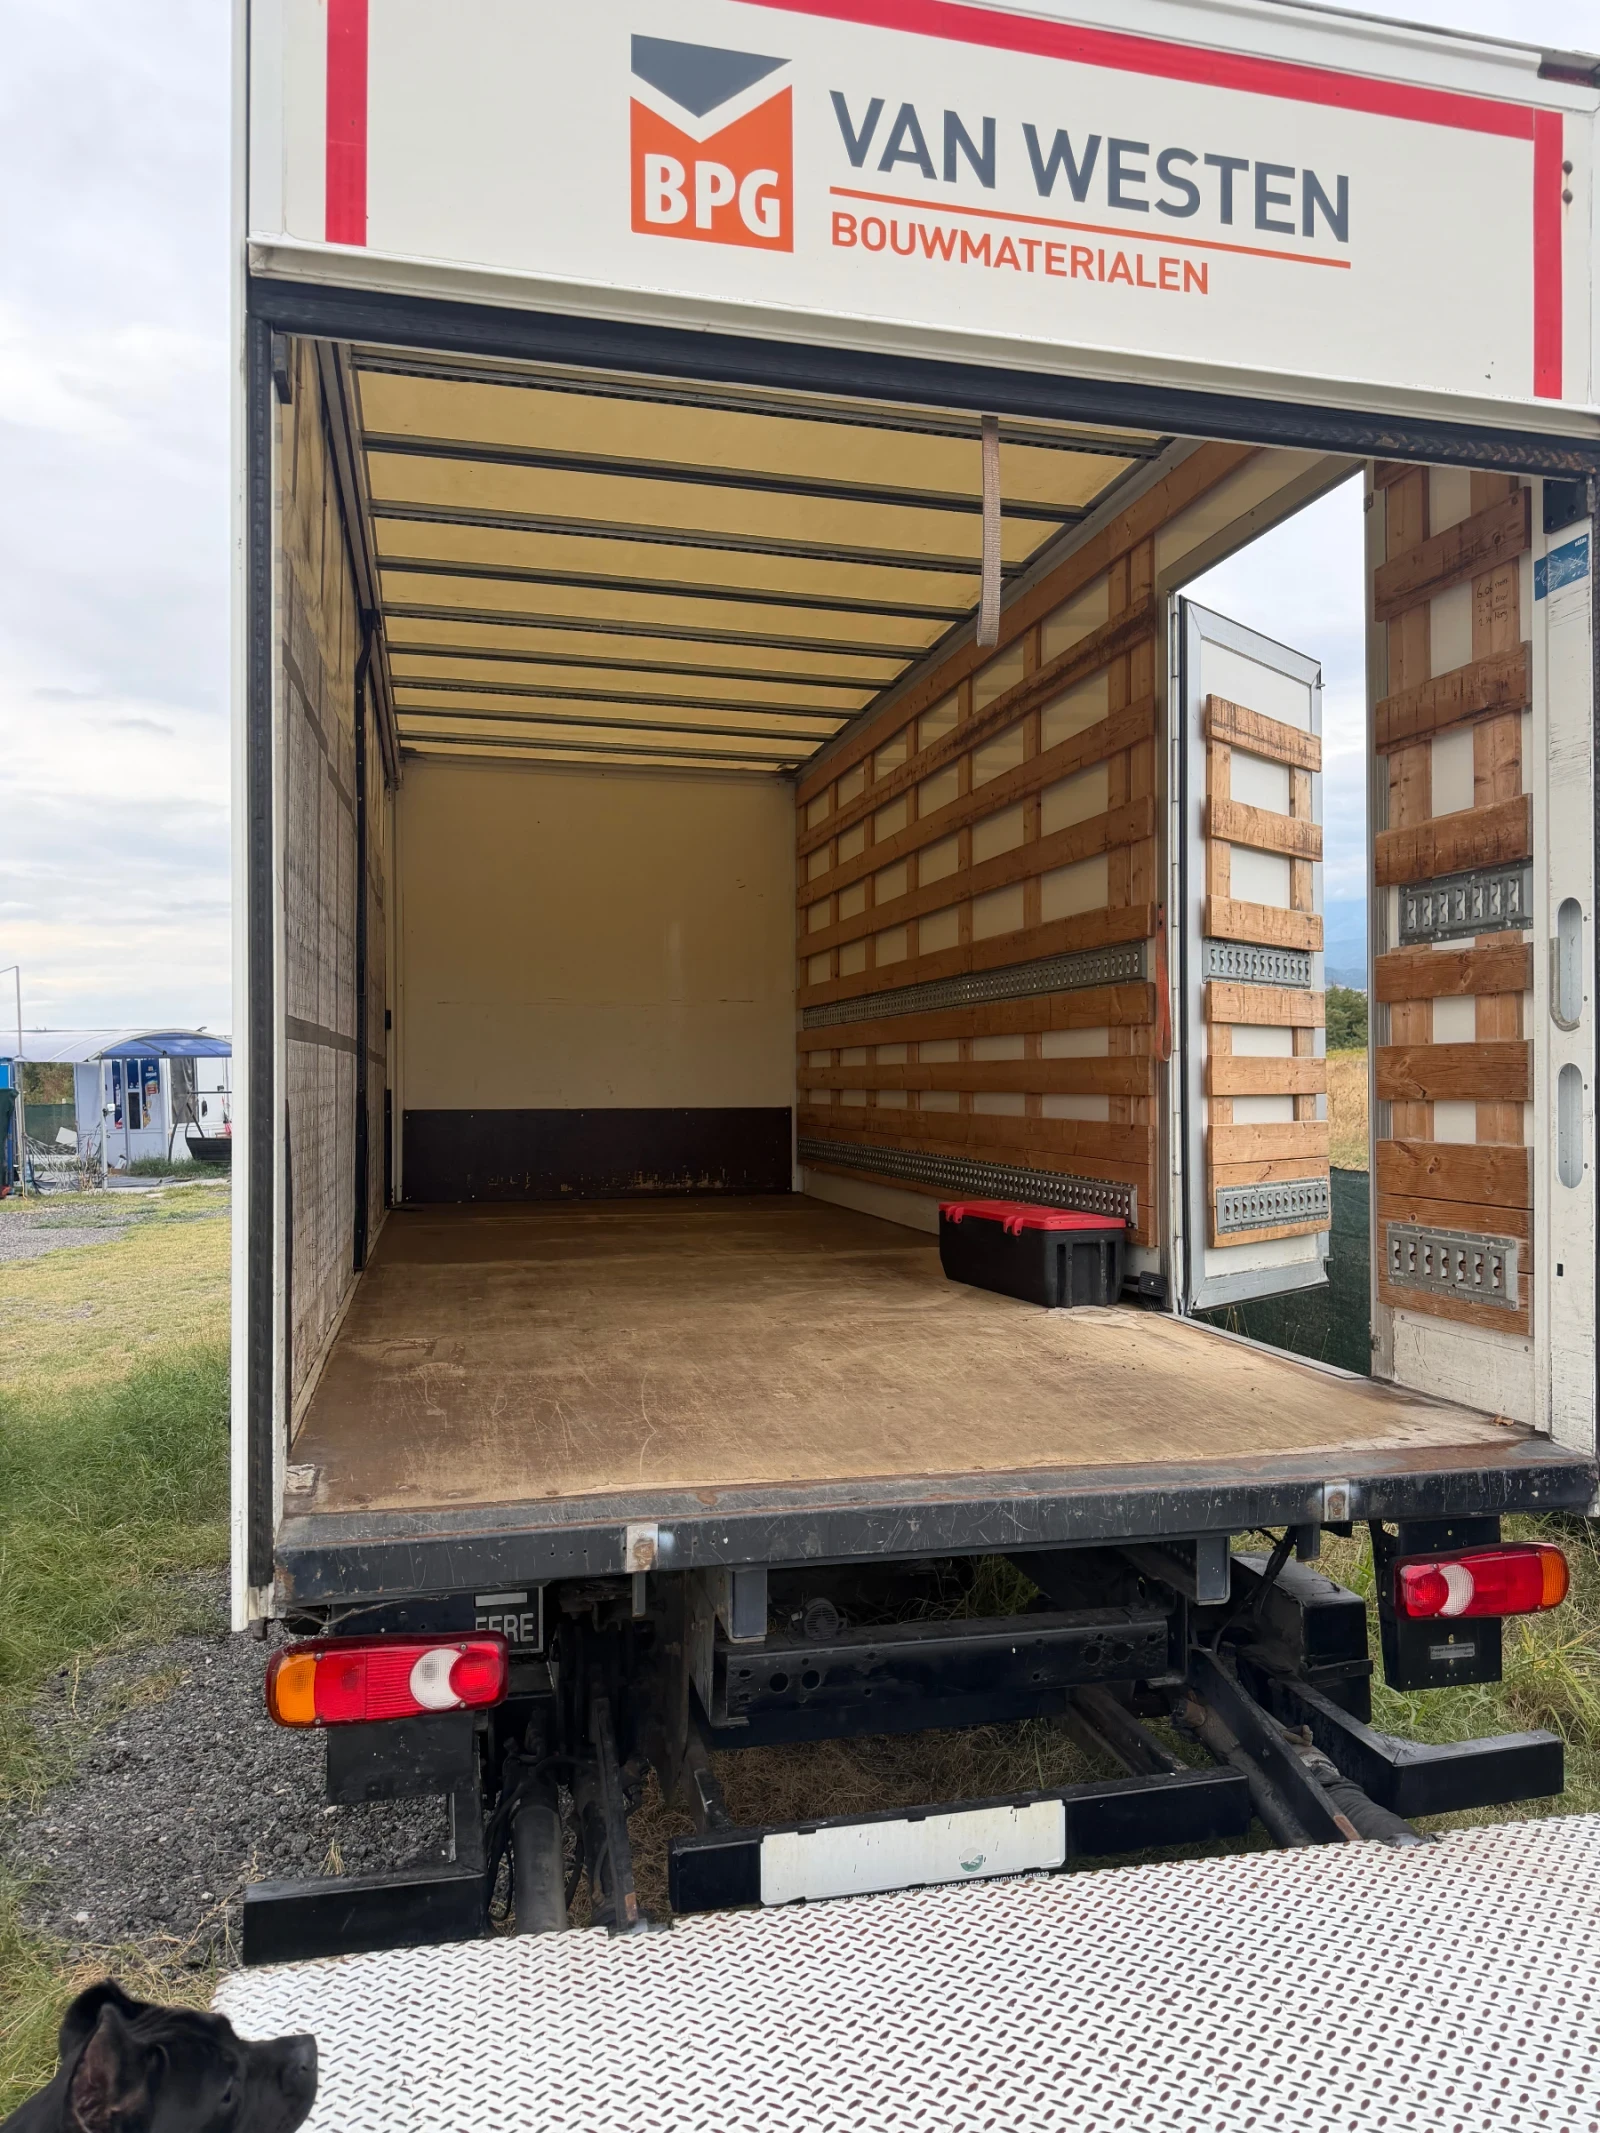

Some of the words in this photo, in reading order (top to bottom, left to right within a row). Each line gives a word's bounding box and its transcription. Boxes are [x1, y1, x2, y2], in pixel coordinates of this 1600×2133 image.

[643, 153, 781, 239] BPG
[830, 90, 997, 189] VAN
[1022, 122, 1349, 243] WESTEN
[831, 211, 1208, 294] BOUWMATERIALEN
